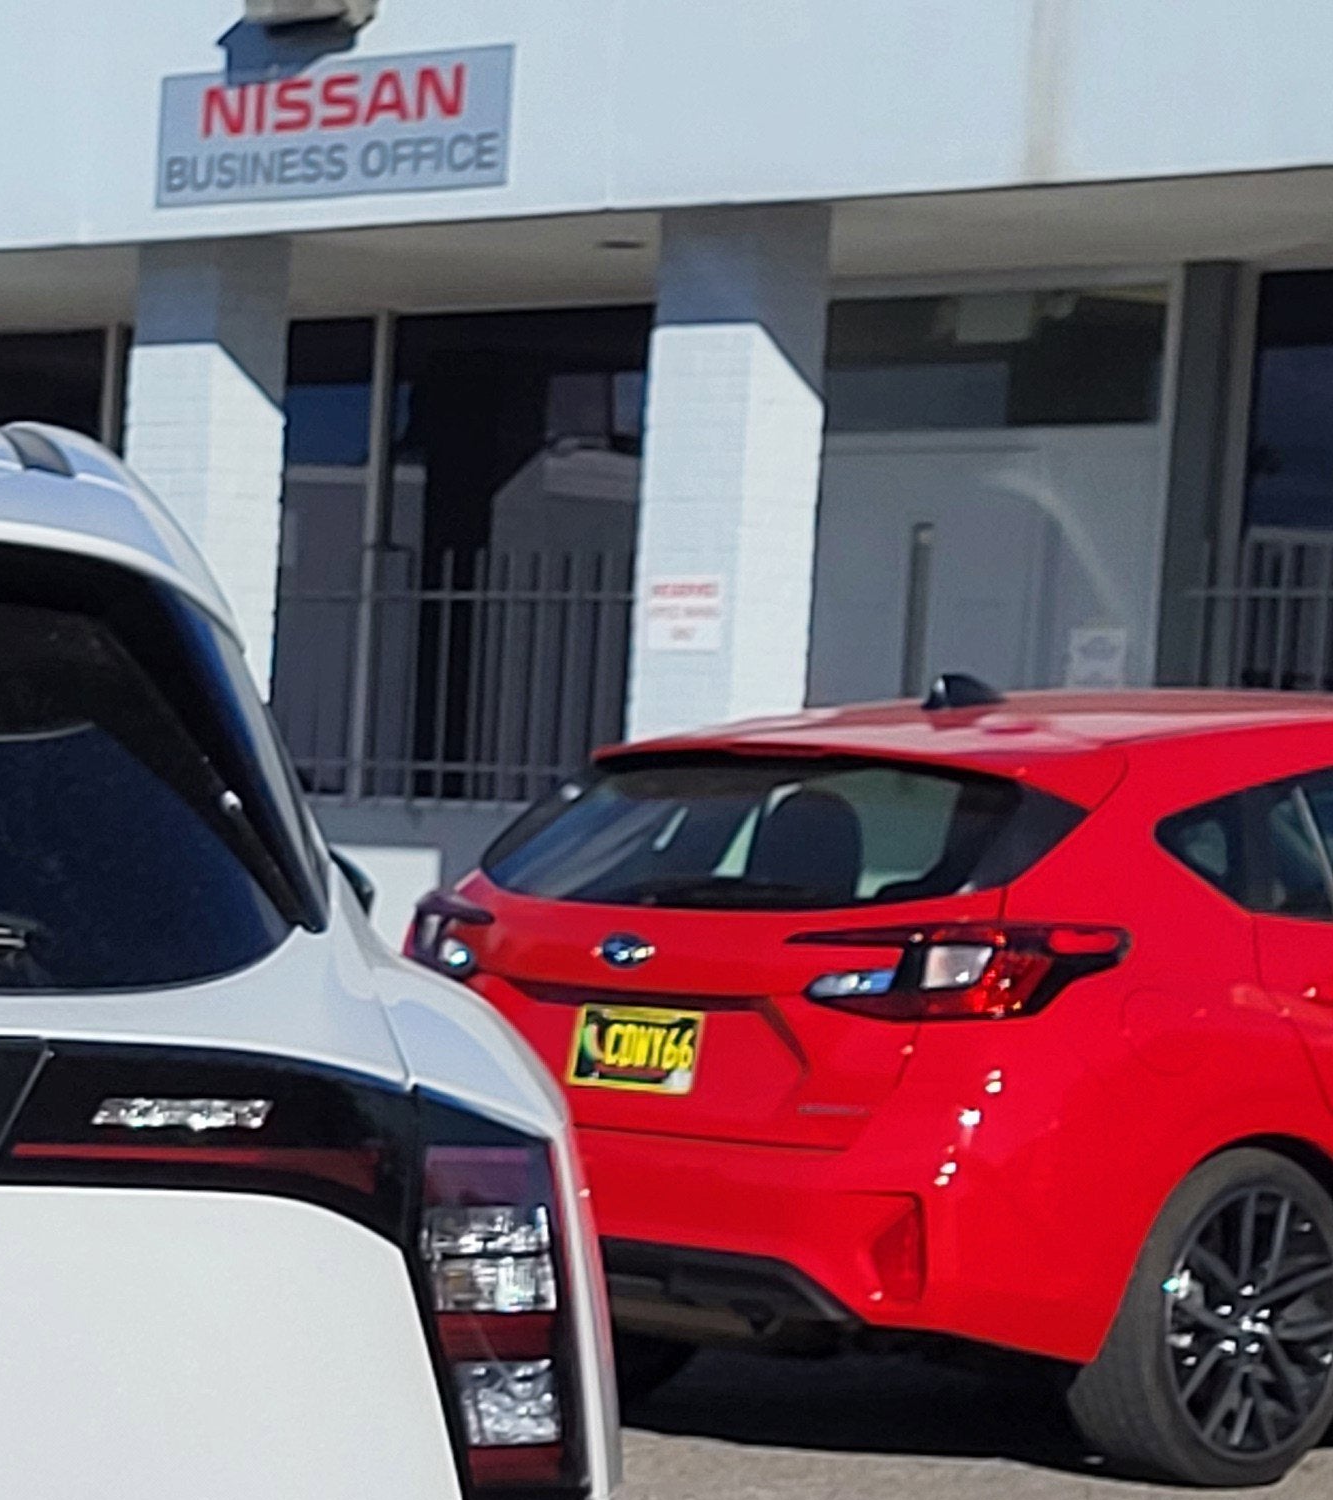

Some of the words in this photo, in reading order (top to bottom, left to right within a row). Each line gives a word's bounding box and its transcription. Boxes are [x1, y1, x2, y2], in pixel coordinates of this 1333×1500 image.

[201, 63, 466, 139] NISSAN
[165, 143, 349, 194] BUSINESS
[360, 131, 500, 179] OFFICE
